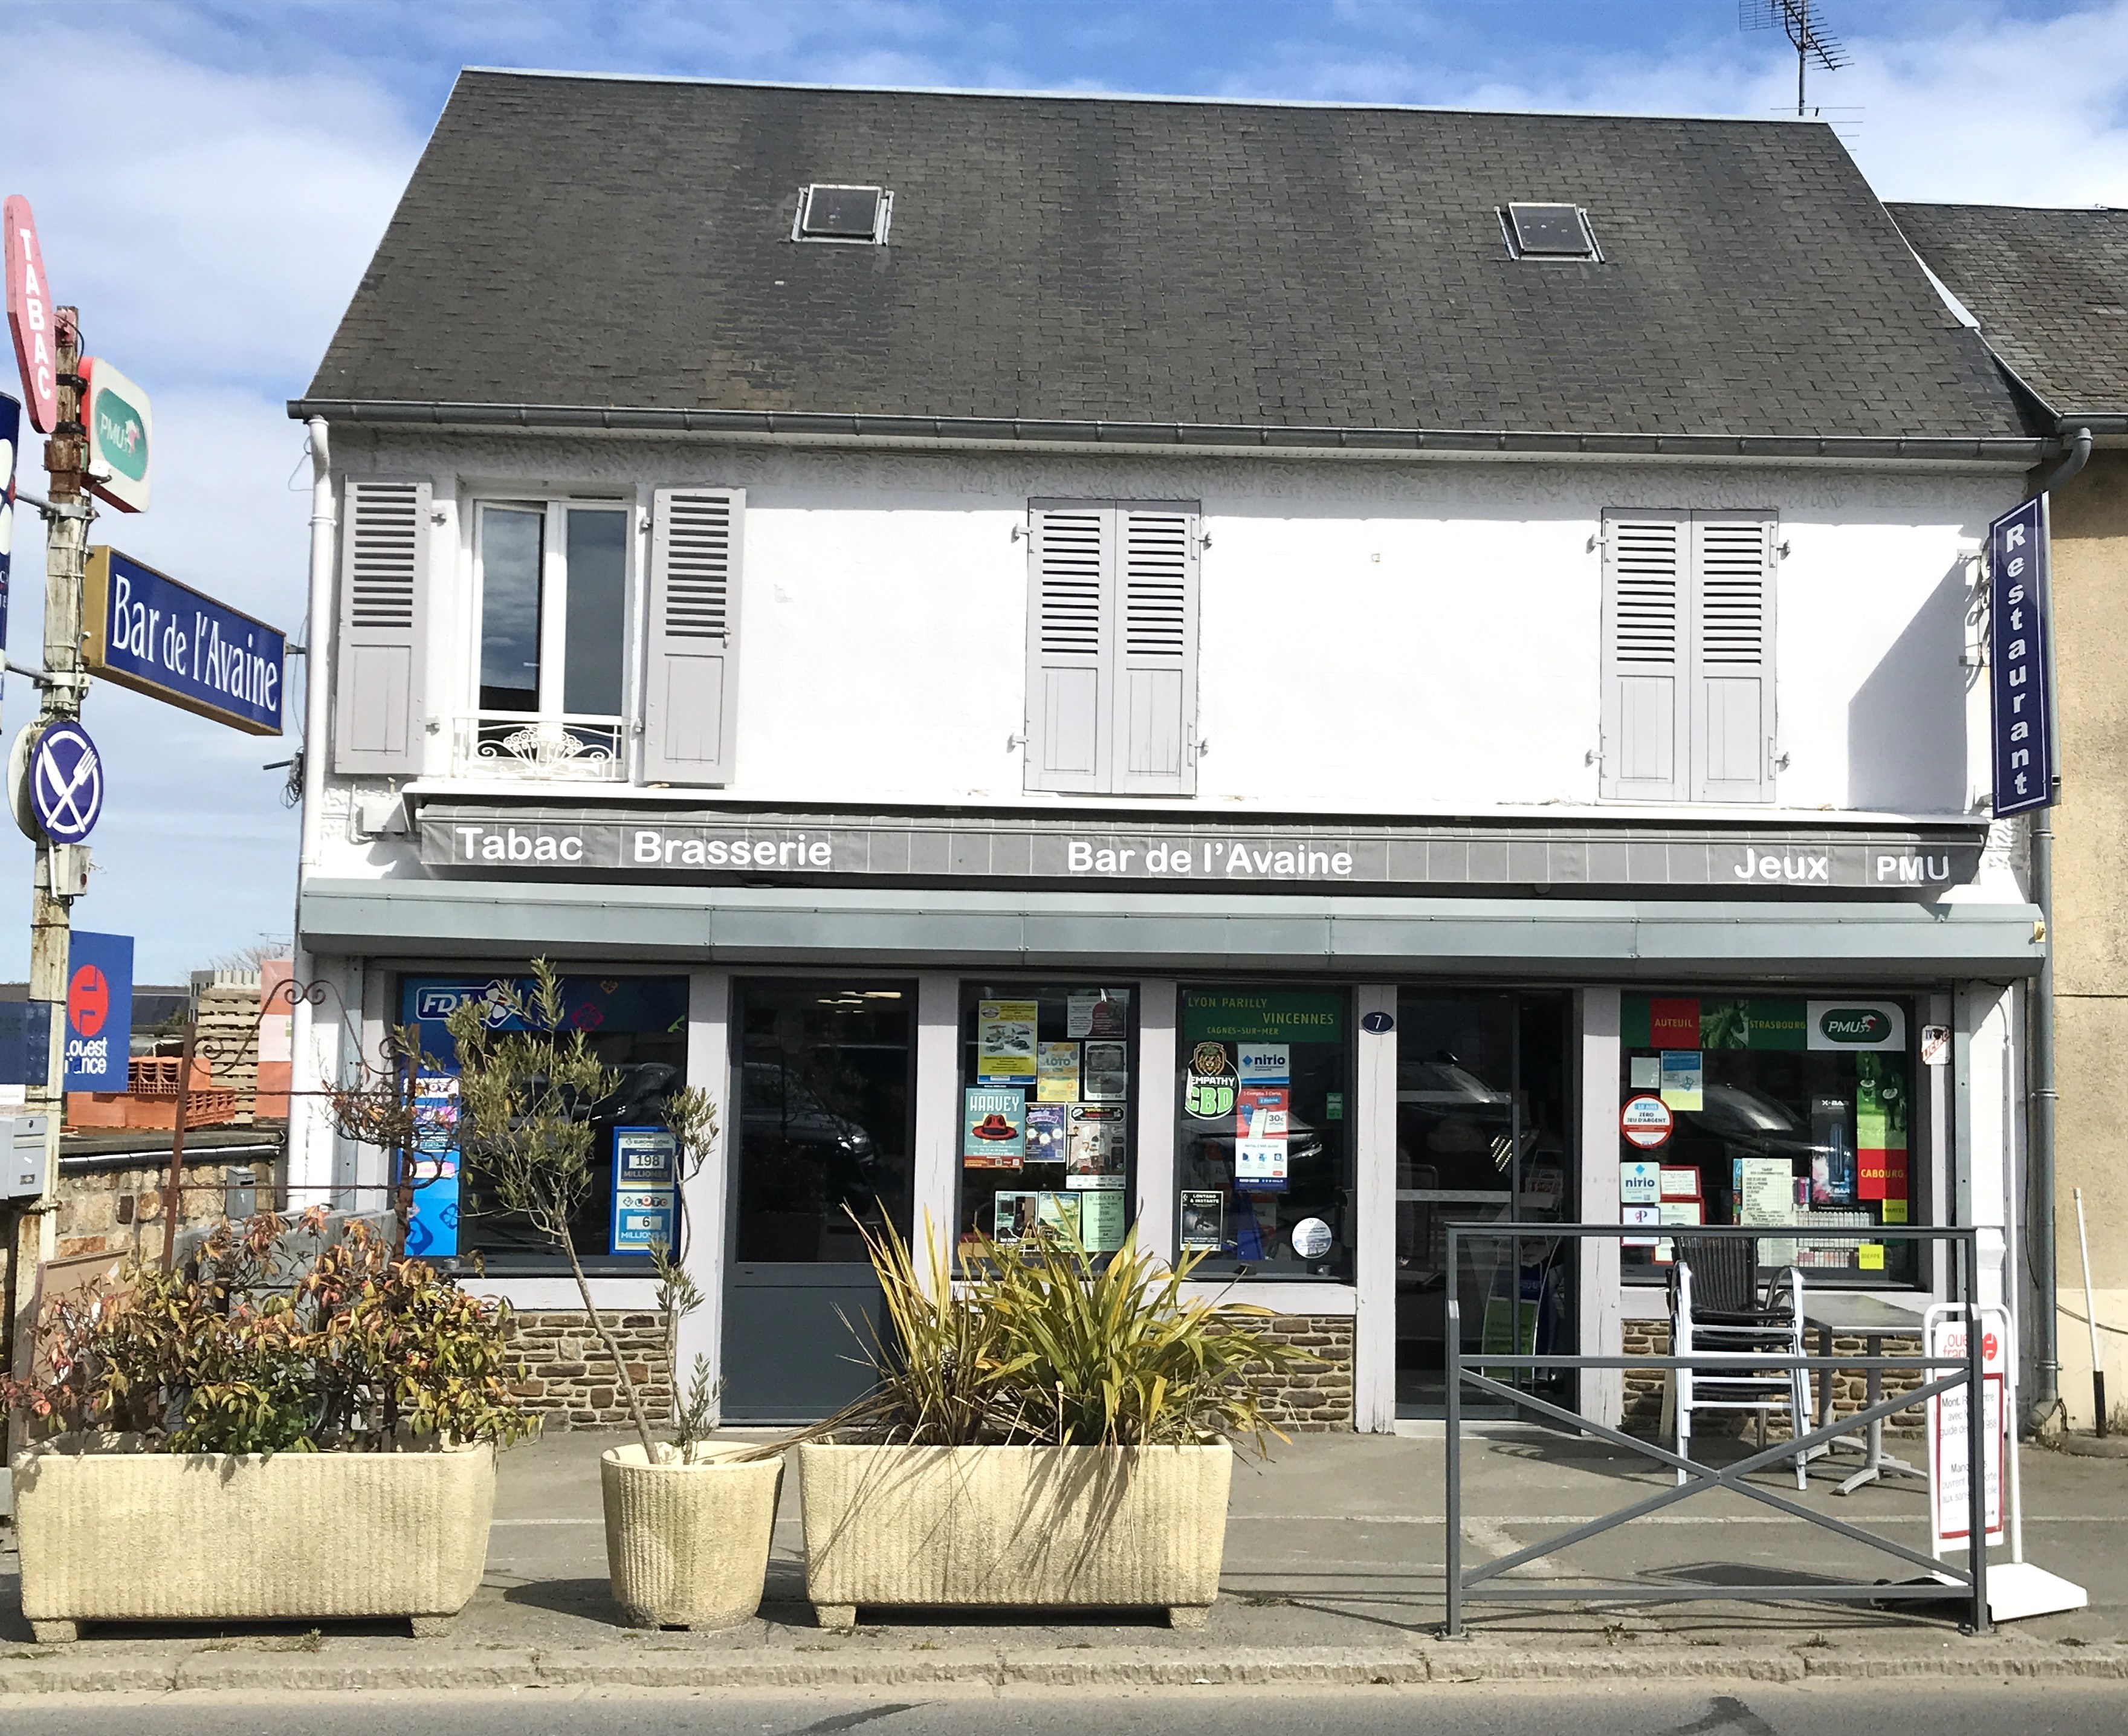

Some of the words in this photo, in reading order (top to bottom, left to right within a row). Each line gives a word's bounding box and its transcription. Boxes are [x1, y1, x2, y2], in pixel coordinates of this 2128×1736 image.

[19, 228, 53, 400] TABAC
[100, 412, 125, 449] PMU
[112, 574, 160, 662] Bar
[163, 614, 187, 675] de
[192, 612, 277, 711] l'Avaine
[2006, 522, 2029, 795] Restaurant
[456, 826, 583, 861] Tabac
[634, 831, 832, 866] Brasserie
[1067, 841, 1136, 872] Bar
[1145, 842, 1192, 872] de
[1204, 843, 1353, 875] l'Avaine
[1734, 847, 1828, 880] Jeux
[1877, 856, 1949, 881] PMU
[1188, 997, 1216, 1007] LYON
[1222, 998, 1267, 1008] PARILLY
[1263, 1012, 1334, 1025] VINCENNES
[1374, 1015, 1383, 1029] 7
[1655, 1018, 1693, 1027] AUTEUIL
[1749, 1020, 1806, 1029] STRASBOURG
[1207, 1026, 1278, 1035] CAGNES-SUR-MER
[1828, 1020, 1861, 1033] PMU
[1925, 1029, 1933, 1039] IV
[1046, 1057, 1071, 1066] LOTO
[1254, 1054, 1286, 1066] nirio
[1191, 1076, 1236, 1087] EMPATHY
[970, 1095, 1020, 1112] HARVEY
[1185, 1087, 1234, 1115] CBD
[636, 1155, 661, 1167] 198
[1861, 1168, 1904, 1178] CABOURG
[1625, 1177, 1655, 1188] nirio
[636, 1195, 668, 1207] LOTO
[642, 1216, 650, 1228] 6
[1947, 1333, 1968, 1347] oue
[1942, 1398, 1961, 1408] Mont.
[1948, 1412, 1963, 1422] avec
[1939, 1425, 1958, 1439] guide
[1942, 1478, 1965, 1490] ouvrent
[1984, 1472, 1997, 1482] orte
